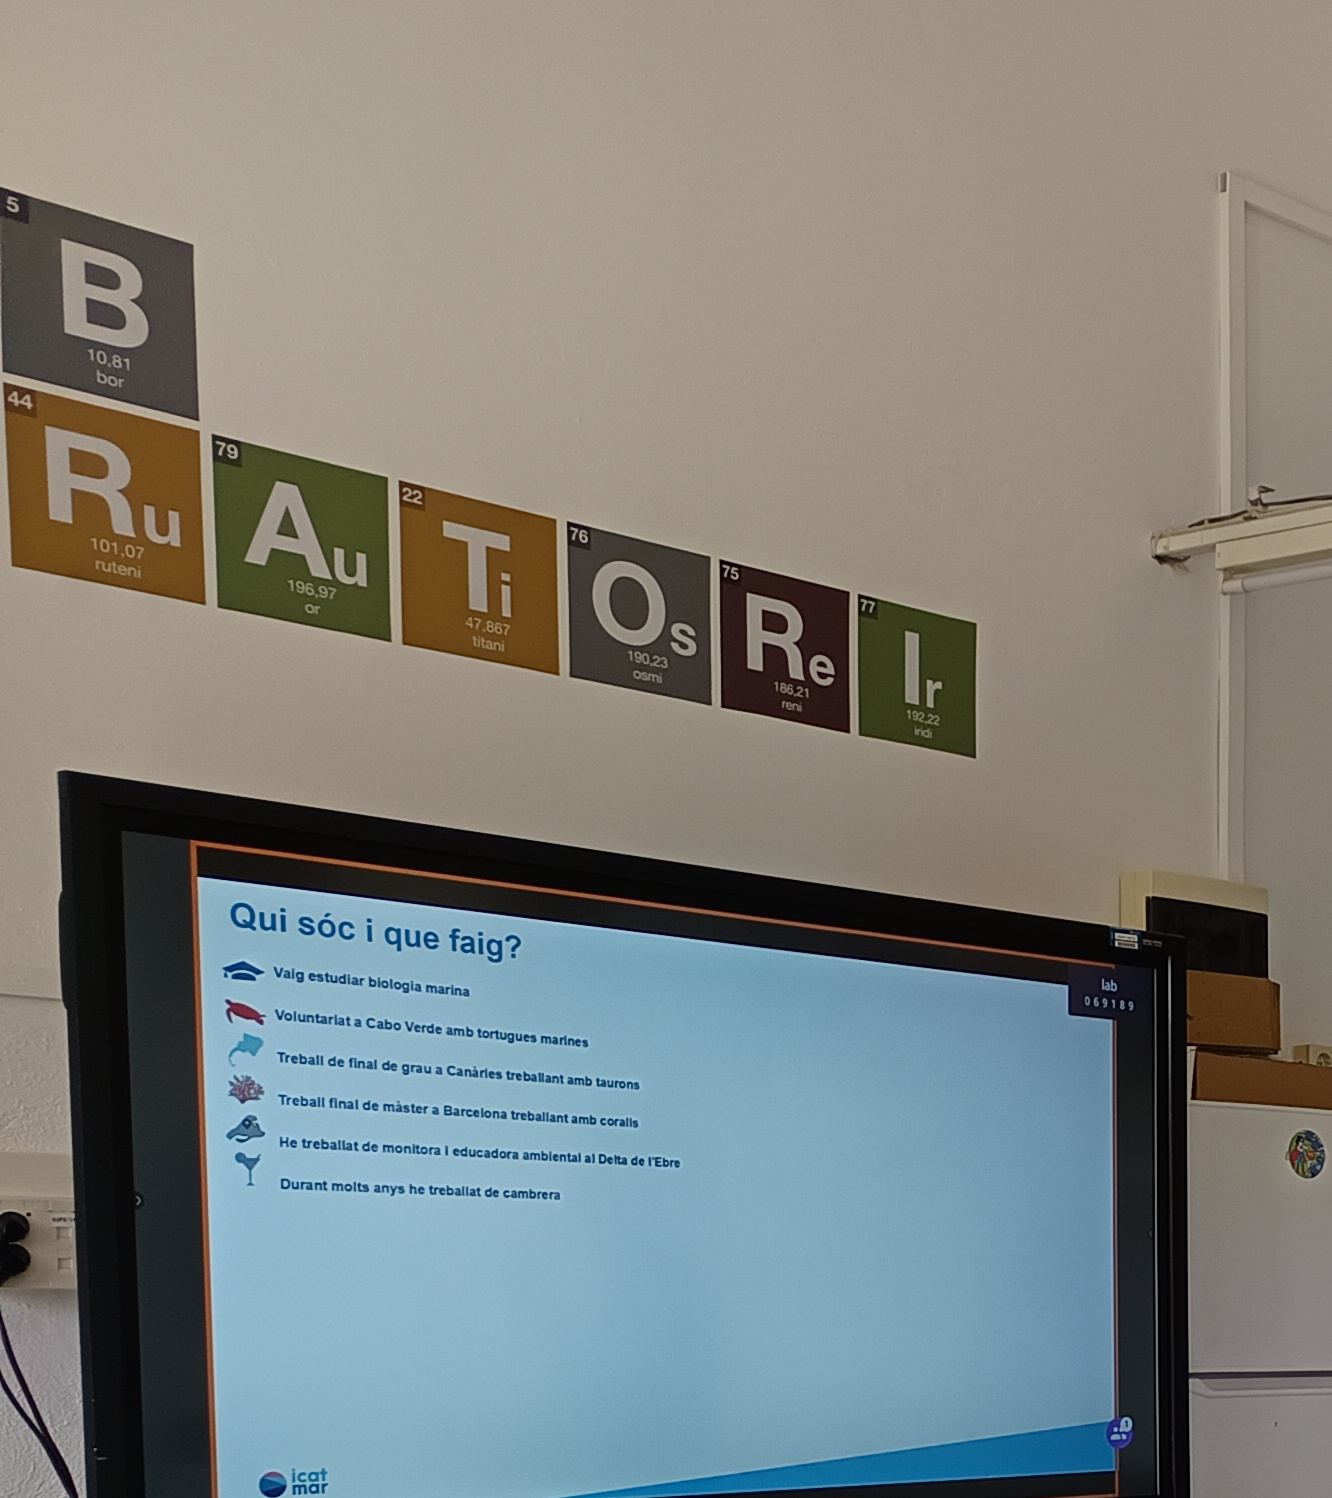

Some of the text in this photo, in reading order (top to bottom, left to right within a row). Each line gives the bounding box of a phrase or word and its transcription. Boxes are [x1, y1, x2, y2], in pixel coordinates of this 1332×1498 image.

[6, 196, 20, 213] 5
[61, 237, 150, 349] B
[87, 348, 131, 371] 10,81
[96, 371, 125, 388] bor
[7, 391, 34, 411] 44
[215, 440, 239, 460] 79
[45, 425, 181, 548] Ru
[401, 486, 423, 506] 22
[244, 480, 367, 588] Au
[570, 527, 589, 544] 76
[90, 537, 145, 561] 101,07
[95, 558, 141, 580] ruteni
[442, 520, 512, 618] Ti
[722, 564, 740, 581] 75
[287, 578, 337, 601] 196,97
[305, 602, 320, 616] or
[592, 560, 698, 658] Os
[860, 598, 876, 615] 77
[465, 616, 511, 637] 47,867
[472, 634, 505, 653] titani
[746, 592, 836, 688] Re
[633, 668, 663, 685] osmi
[904, 630, 942, 709] Ir
[781, 698, 802, 713] reni
[914, 726, 933, 740] iridi
[230, 901, 522, 963] Qui sóc i que faig?
[273, 966, 470, 997] Vaig estudiar biologia marina
[1101, 977, 1118, 992] lab
[275, 1009, 589, 1048] Voluntariat a Cabo Verde amb tortugues marines
[277, 1051, 640, 1091] Treball de final de grau a Canàries treballant amb taurons
[278, 1094, 325, 1109] Treball
[329, 1096, 359, 1111] final
[362, 1099, 379, 1112] de
[382, 1100, 428, 1116] màster
[431, 1106, 440, 1116] a
[443, 1105, 507, 1121] Barcelona
[510, 1109, 569, 1124] treballant
[571, 1113, 597, 1126] amb
[279, 1136, 298, 1149] He
[302, 1138, 359, 1152] treballat
[363, 1140, 379, 1153] de
[382, 1143, 441, 1157] monitora
[452, 1145, 519, 1161] educadora
[522, 1149, 582, 1163] ambiental
[584, 1152, 595, 1164] al
[598, 1153, 628, 1166] Delta
[630, 1155, 645, 1168] de
[280, 1178, 561, 1201] Durant molts anys he treballat de cambrera
[291, 1467, 328, 1484] icat
[291, 1481, 329, 1496] mar
